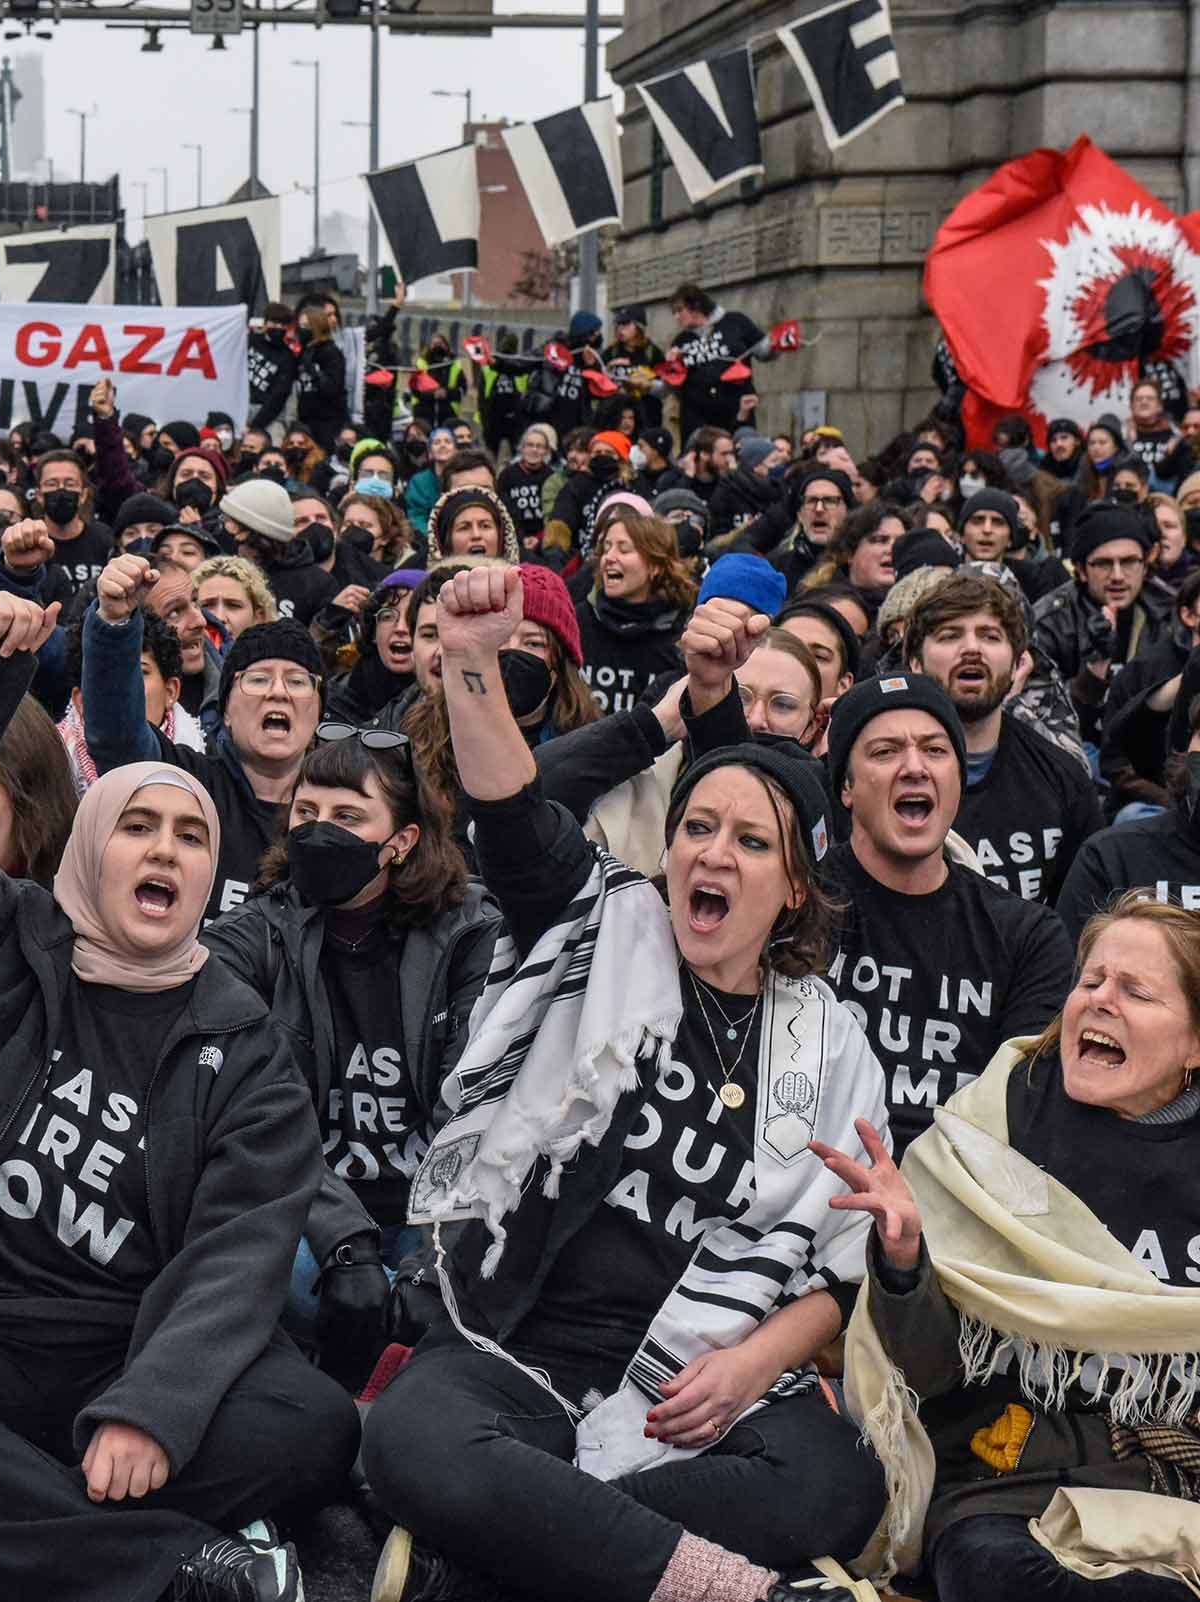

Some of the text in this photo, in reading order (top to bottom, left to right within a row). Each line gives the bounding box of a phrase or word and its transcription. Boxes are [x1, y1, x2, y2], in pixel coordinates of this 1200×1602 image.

[14, 321, 218, 380] GAZA
[510, 485, 539, 499] NOT
[517, 495, 541, 509] OU
[578, 665, 634, 689] NOT
[591, 690, 634, 712] OU
[939, 975, 992, 1016] IN
[17, 1103, 126, 1193] IRE
